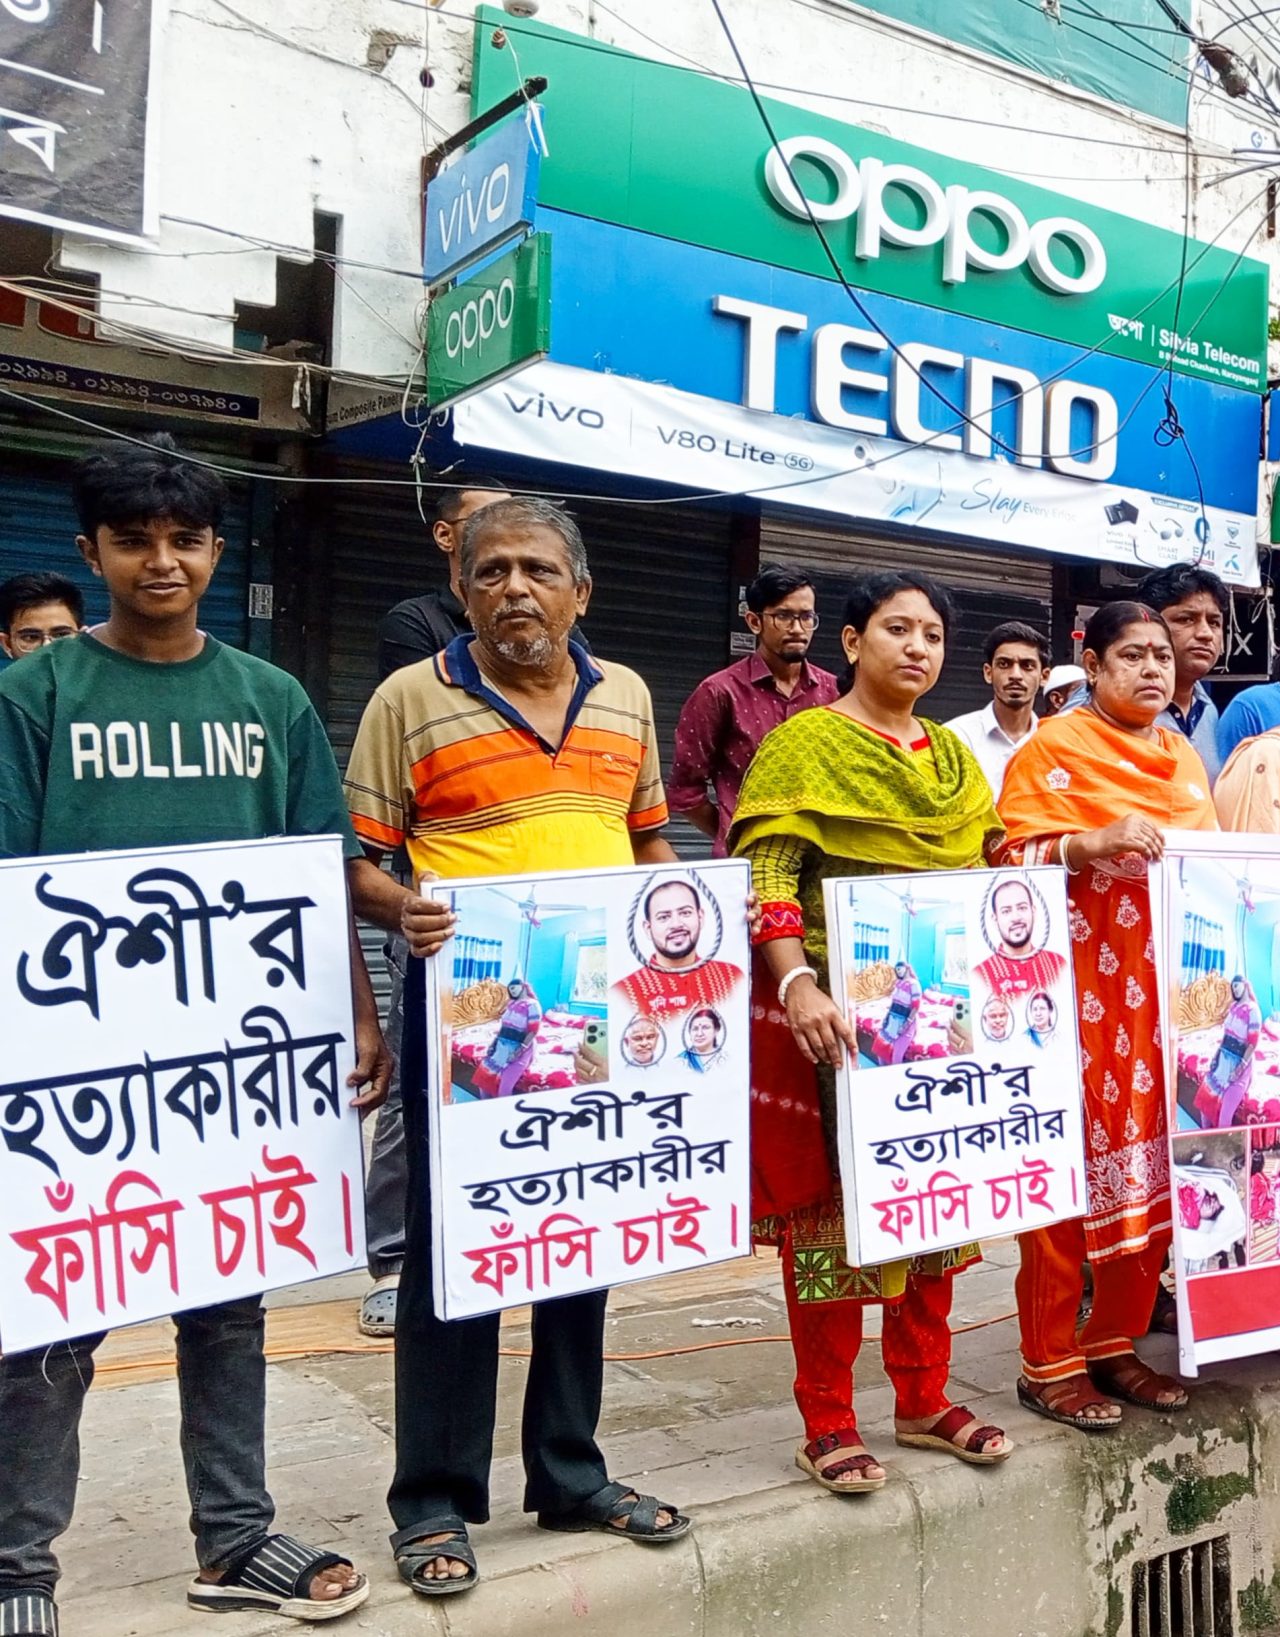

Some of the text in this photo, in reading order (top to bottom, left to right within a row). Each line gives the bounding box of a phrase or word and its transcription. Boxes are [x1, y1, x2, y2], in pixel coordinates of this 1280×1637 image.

[439, 163, 509, 254] vivo
[446, 277, 514, 367] oppo
[1159, 328, 1260, 374] Silvia Telecom
[502, 392, 604, 430] vivo
[713, 294, 1118, 481] TECNO
[657, 425, 810, 470] V80 Lite 5G
[960, 478, 1022, 524] Slay
[70, 721, 265, 780] ROLLING
[0, 1006, 346, 1178] হত্যাকারীর
[461, 1135, 732, 1214] হত্যাকারীর
[869, 1104, 1068, 1169] হত্যাকারীর
[871, 1171, 974, 1244] ফাঁসি
[9, 1170, 185, 1322] ফাঁসি
[462, 1213, 600, 1297] ফাঁসি
